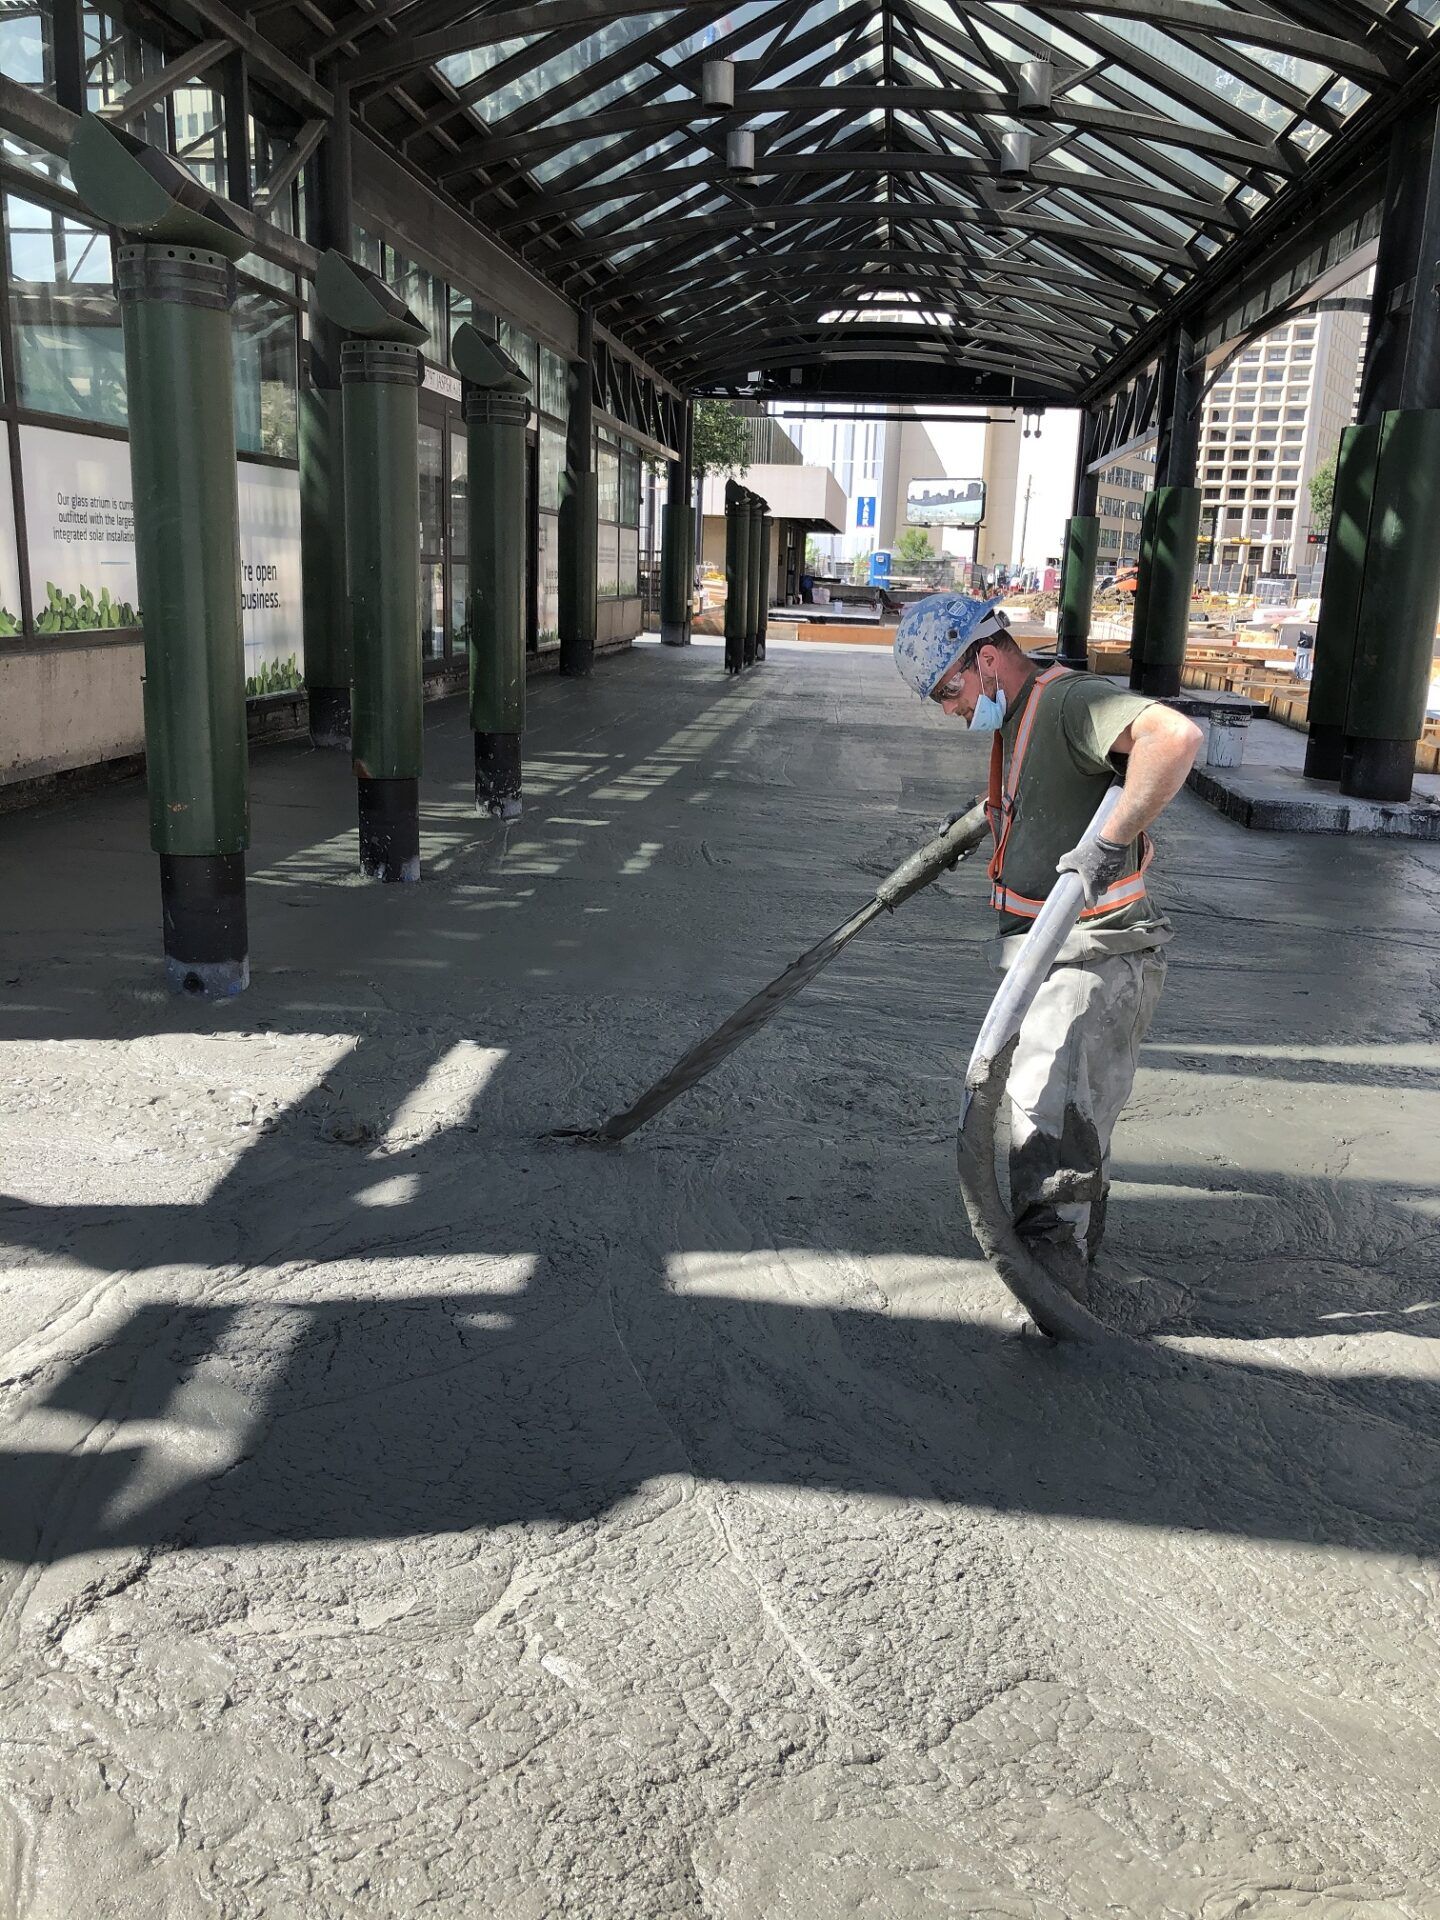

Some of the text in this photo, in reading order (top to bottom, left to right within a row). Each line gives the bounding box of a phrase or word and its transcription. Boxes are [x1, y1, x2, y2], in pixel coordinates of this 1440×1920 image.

[57, 492, 69, 505] Our
[71, 494, 88, 509] glass
[90, 496, 110, 509] atrium
[111, 497, 117, 509] is
[58, 511, 87, 524] outfitted
[89, 513, 103, 525] with
[105, 514, 115, 526] the
[53, 526, 87, 543] integrated
[89, 529, 104, 541] solar
[256, 565, 277, 587] open
